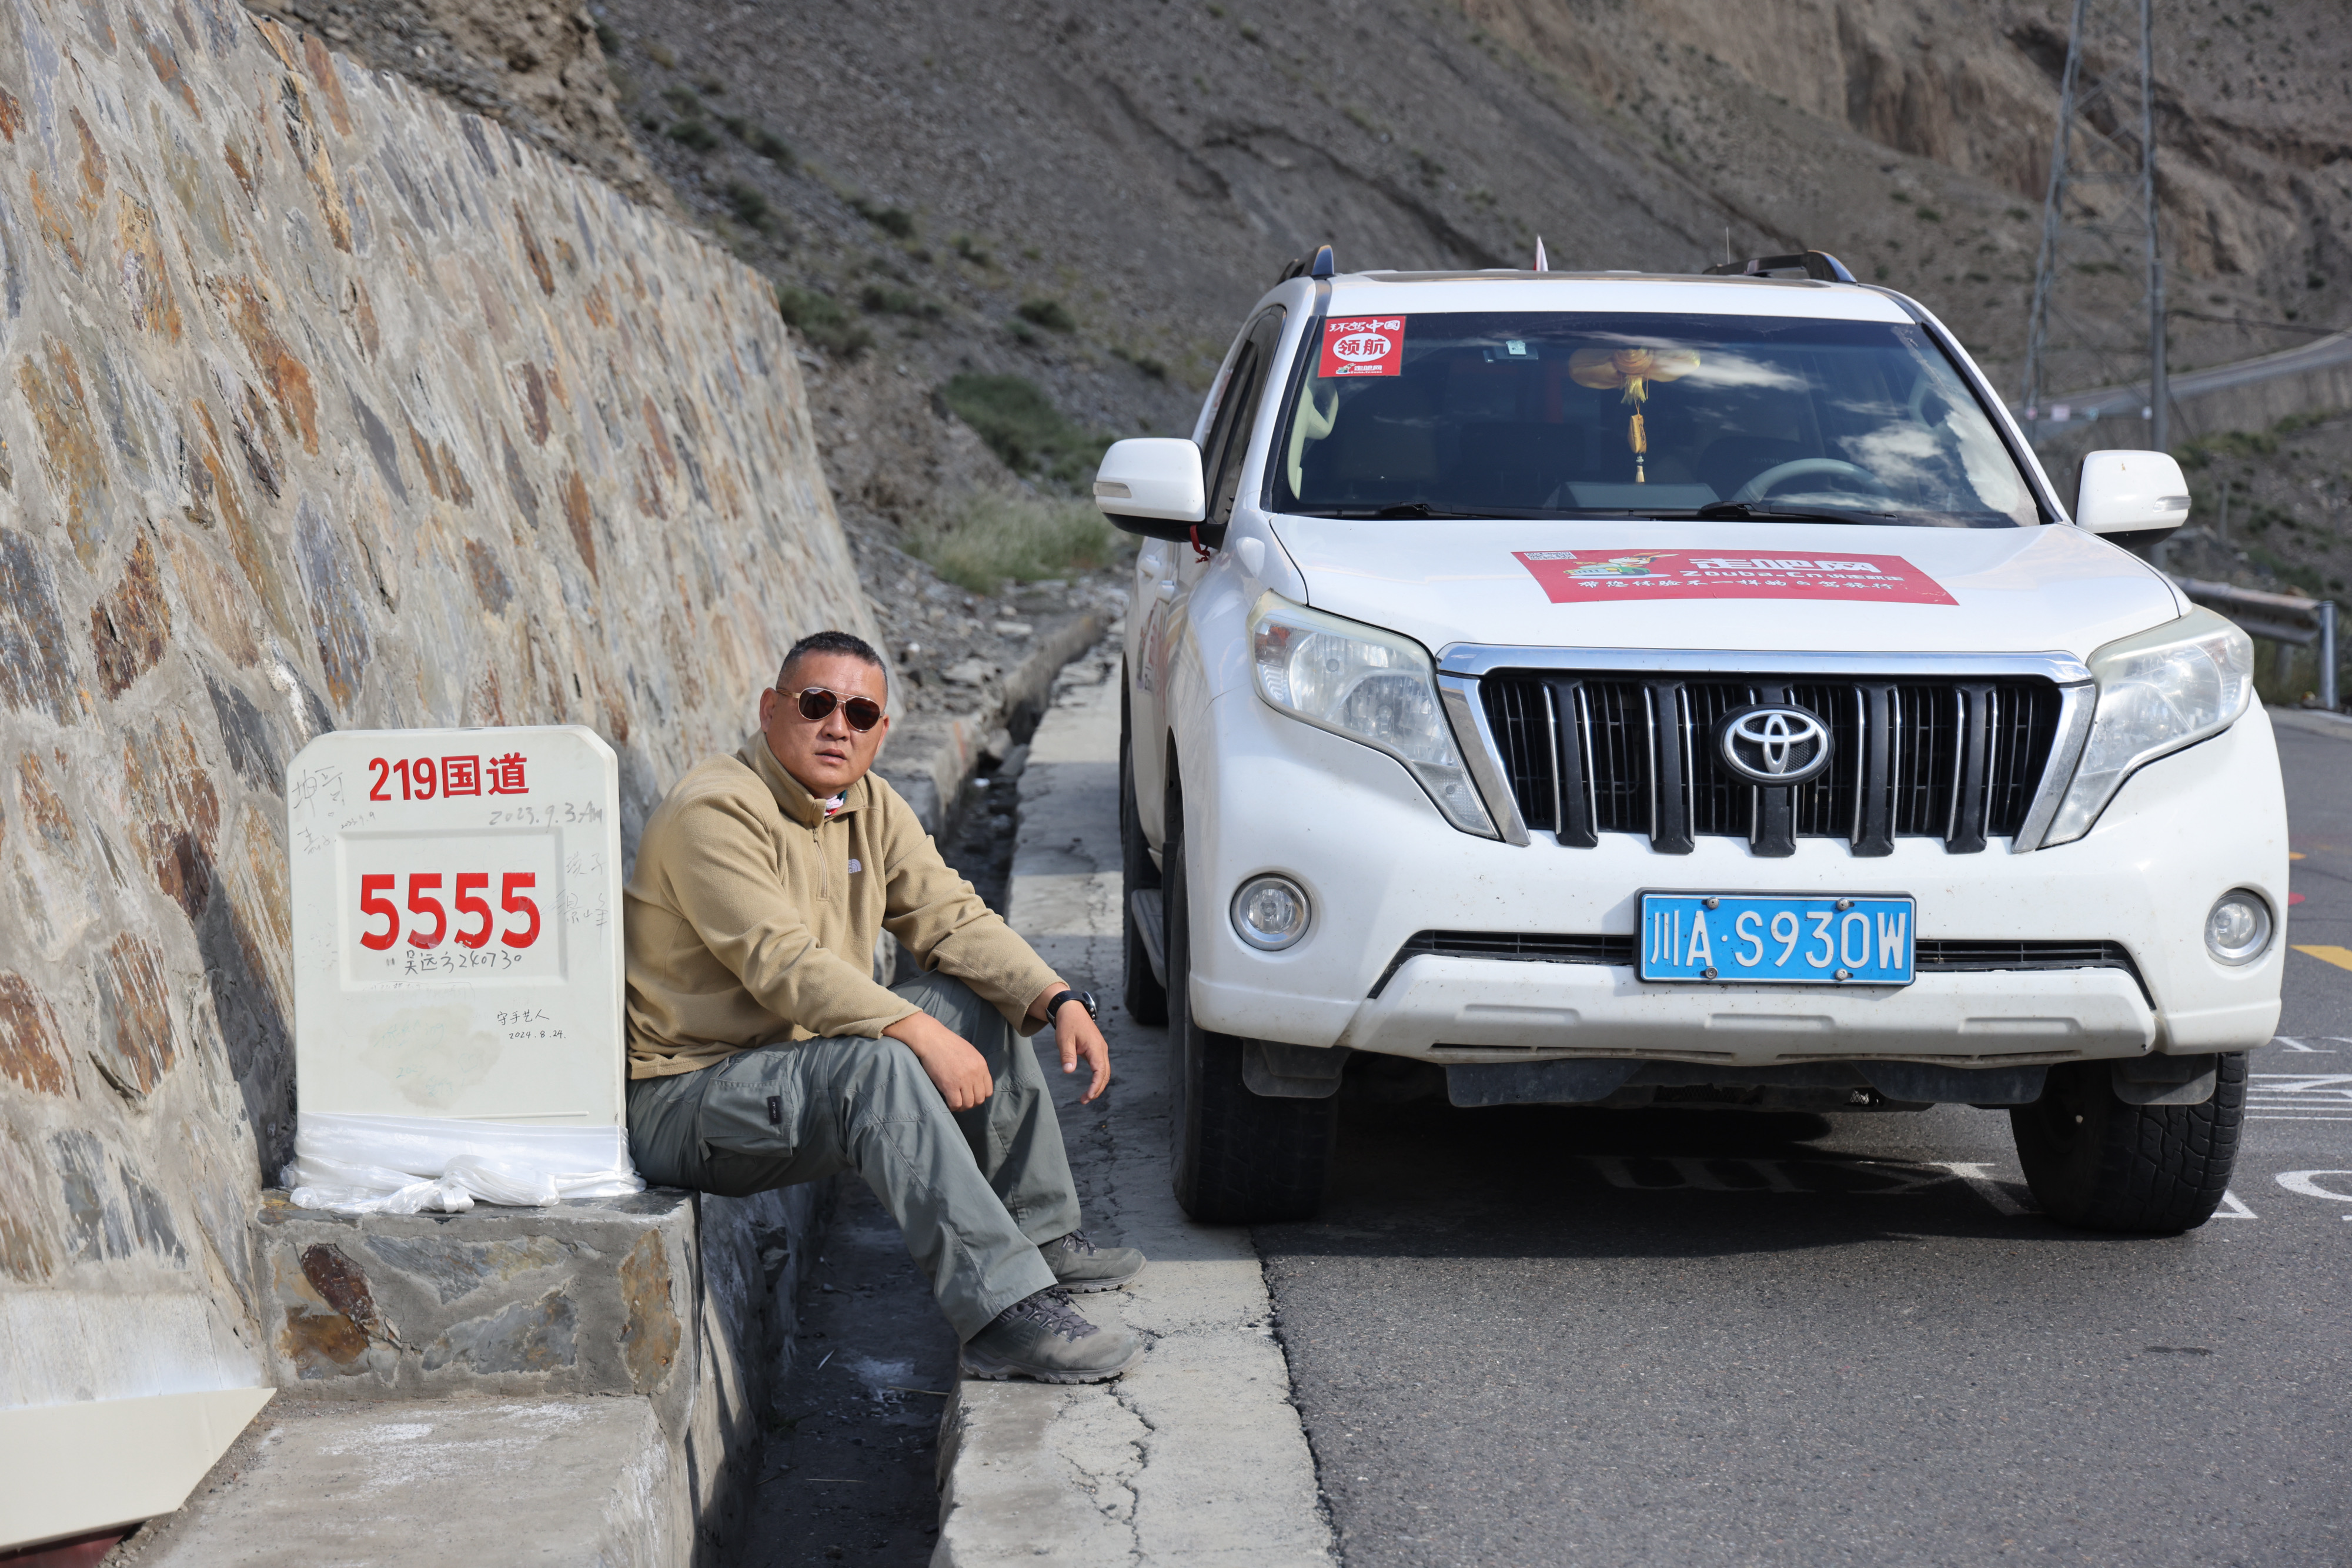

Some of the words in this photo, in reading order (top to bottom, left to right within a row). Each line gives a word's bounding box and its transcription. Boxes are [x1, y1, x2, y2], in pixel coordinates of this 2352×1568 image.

[1338, 339, 1386, 356] 领航
[1688, 558, 1882, 573] 走吧网
[369, 752, 529, 801] 219国道
[359, 872, 541, 951] 5555
[497, 1009, 550, 1025] 守手艺人
